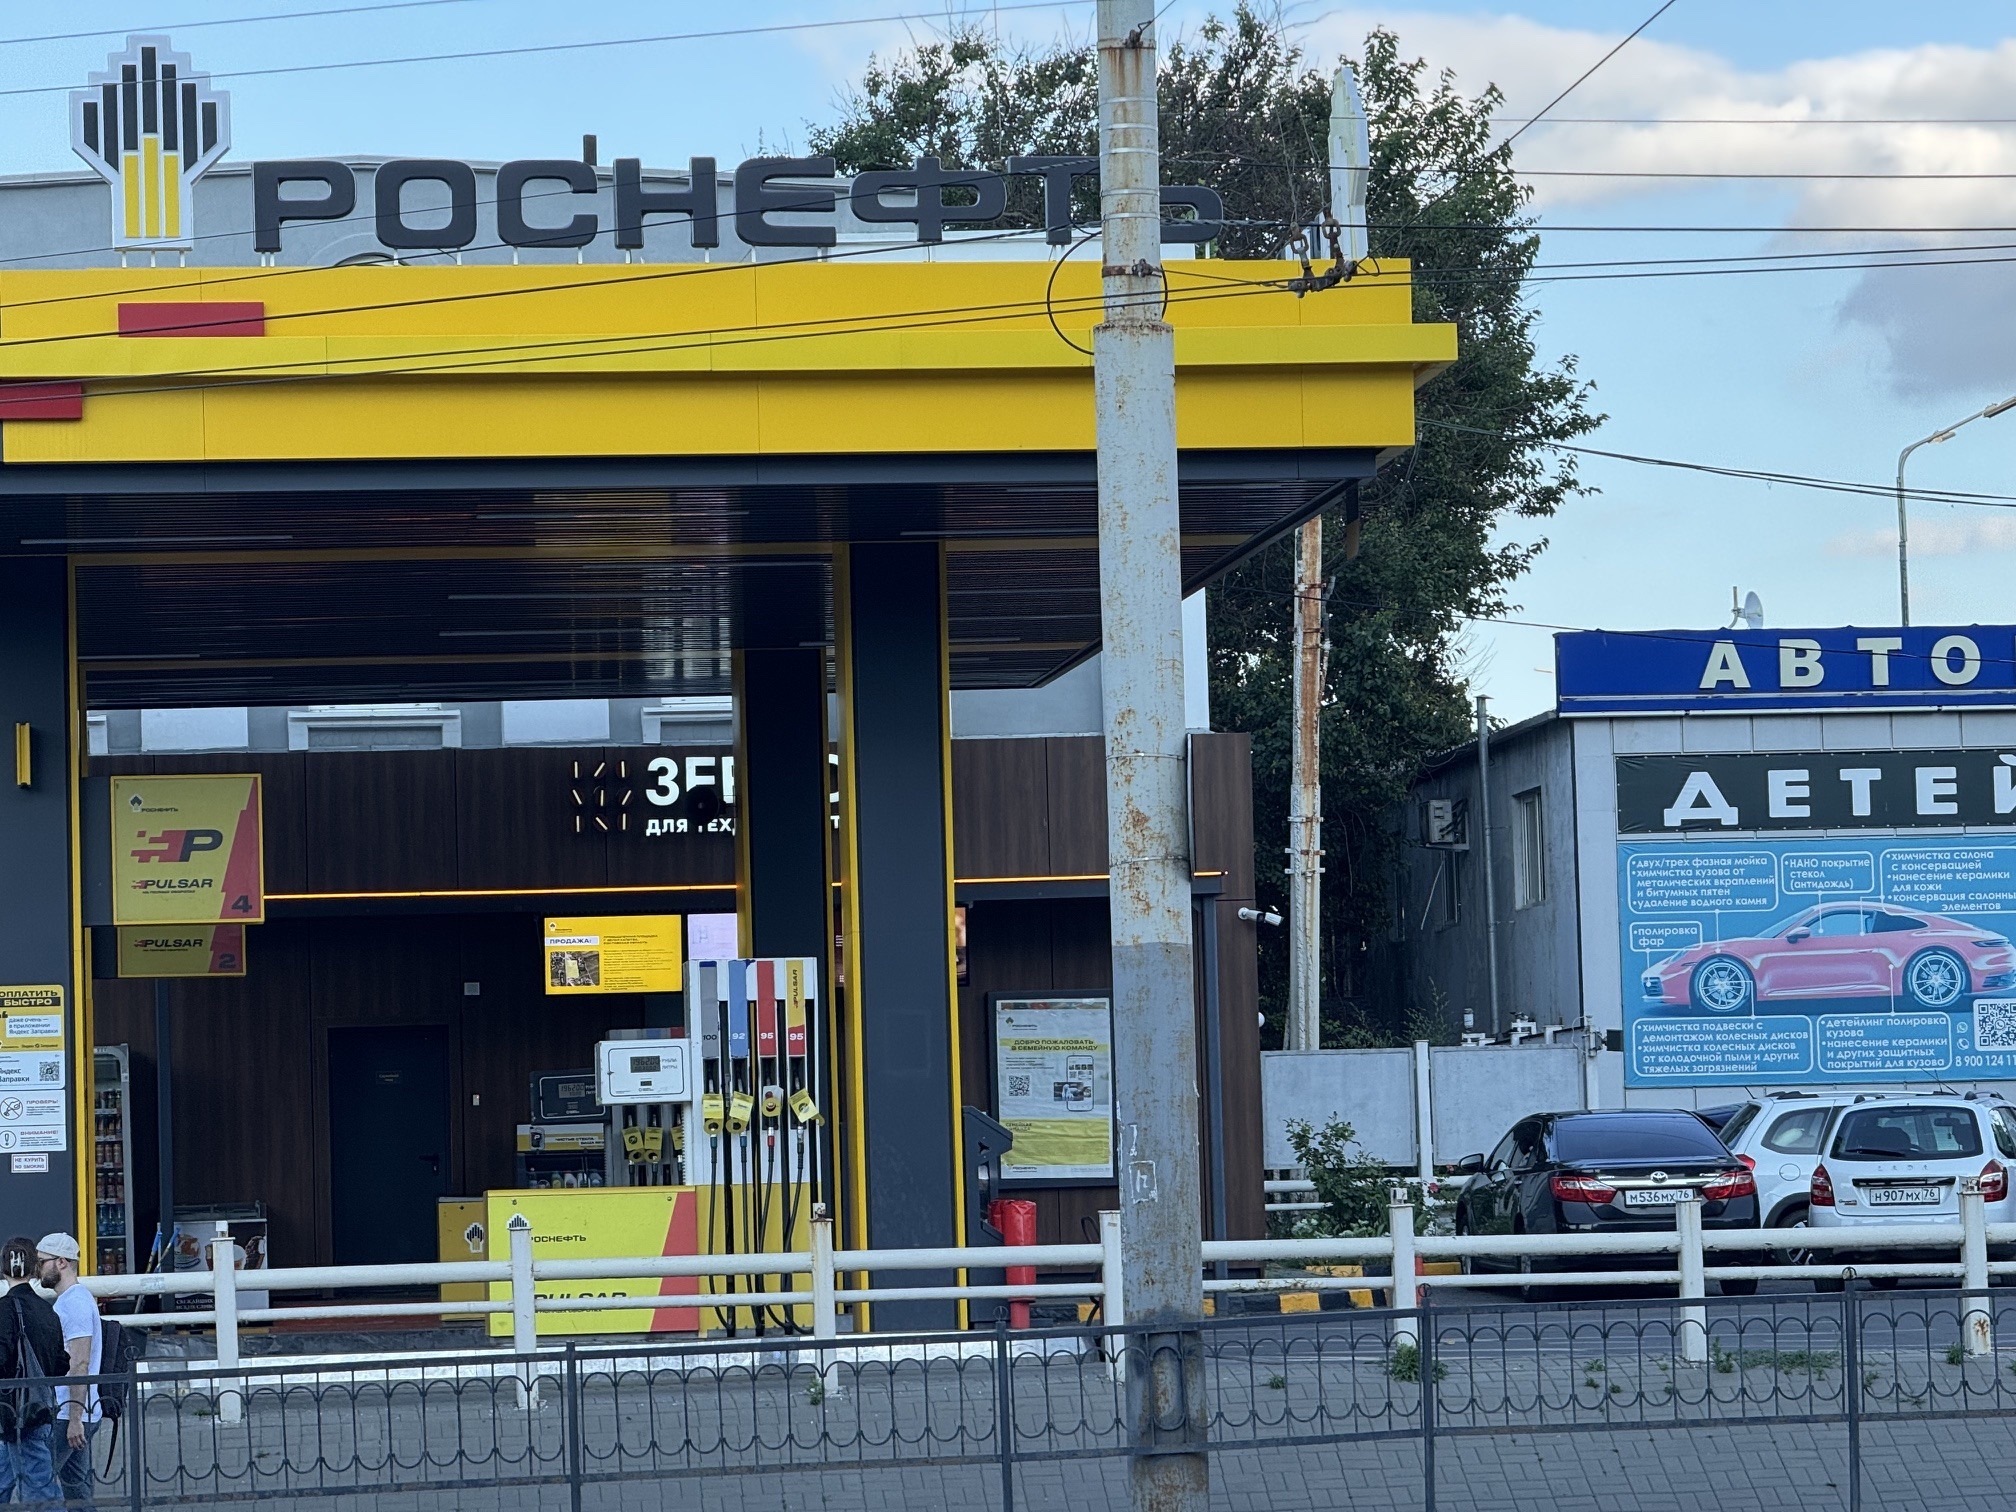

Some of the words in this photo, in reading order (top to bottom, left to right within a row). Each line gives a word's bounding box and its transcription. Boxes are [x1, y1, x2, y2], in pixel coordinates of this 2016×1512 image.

[251, 154, 1223, 252] РОСНЕФТЬ
[1699, 635, 2016, 688] АВТО
[1891, 852, 1951, 861] химчистка
[1953, 850, 1994, 859] салона
[1636, 858, 1690, 868] двух/трех
[1692, 857, 1731, 868] фазная
[1734, 855, 1768, 865] мойка
[1789, 859, 1819, 868] НАНО
[1821, 859, 1870, 869] покрытие
[1901, 860, 1982, 872] консервацией
[1636, 869, 1693, 877] химчистка
[1695, 868, 1730, 877] кузова
[1732, 868, 1745, 876] от
[1790, 870, 1825, 879] стекол
[1892, 872, 1953, 882] нанесение
[1955, 871, 2010, 881] керамики
[144, 879, 213, 889] PULSAR
[1637, 879, 1712, 887] металических
[1714, 875, 1775, 886] вкраплений
[1790, 878, 1853, 890] (антидождь)
[1646, 888, 1699, 898] битумных
[1701, 888, 1731, 896] пятен
[1892, 884, 1911, 893] для
[1914, 883, 1942, 892] кожи
[1893, 893, 1965, 902] консервация
[231, 895, 252, 913] 4
[1638, 899, 1688, 909] удаление
[1691, 898, 1733, 907] водного
[1941, 902, 2001, 911] элементов
[1638, 927, 1698, 937] полировка
[144, 939, 203, 947] PULSAR
[1639, 936, 1664, 947] фар
[219, 954, 236, 969] 2
[4, 998, 53, 1006] БЫСТРО
[1642, 1023, 1700, 1032] химчистка
[1702, 1022, 1754, 1031] подвески
[1757, 1022, 1763, 1030] с
[1826, 1016, 1884, 1027] детейлинг
[1886, 1017, 1947, 1027] полировка
[1642, 1034, 1713, 1043] демонтажом
[1716, 1033, 1768, 1041] колесных
[1770, 1031, 1808, 1040] дисков
[1826, 1029, 1864, 1038] кузова
[1643, 1044, 1701, 1053] химчистка
[1703, 1042, 1755, 1051] колесных
[1758, 1042, 1796, 1051] дисков
[1827, 1039, 1889, 1048] нанесение
[1892, 1037, 1947, 1047] керамики
[1643, 1055, 1656, 1063] от
[1658, 1052, 1722, 1063] колодочной
[1724, 1053, 1751, 1062] пыли
[1754, 1053, 1760, 1061] и
[1763, 1052, 1800, 1062] других
[1827, 1050, 1834, 1058] и
[1836, 1050, 1875, 1060] других
[1877, 1048, 1935, 1058] защитных
[1827, 1058, 1882, 1070] покрытий
[1884, 1059, 1904, 1068] для
[1907, 1058, 1945, 1069] кузова
[1955, 1056, 1962, 1067] 8
[1964, 1055, 1983, 1066] 900
[1985, 1055, 2004, 1066] 124
[1643, 1064, 1690, 1073] тяжелых
[1692, 1062, 1758, 1073] загрязнений
[1678, 1190, 1689, 1198] 76
[1924, 1189, 1935, 1198] 76
